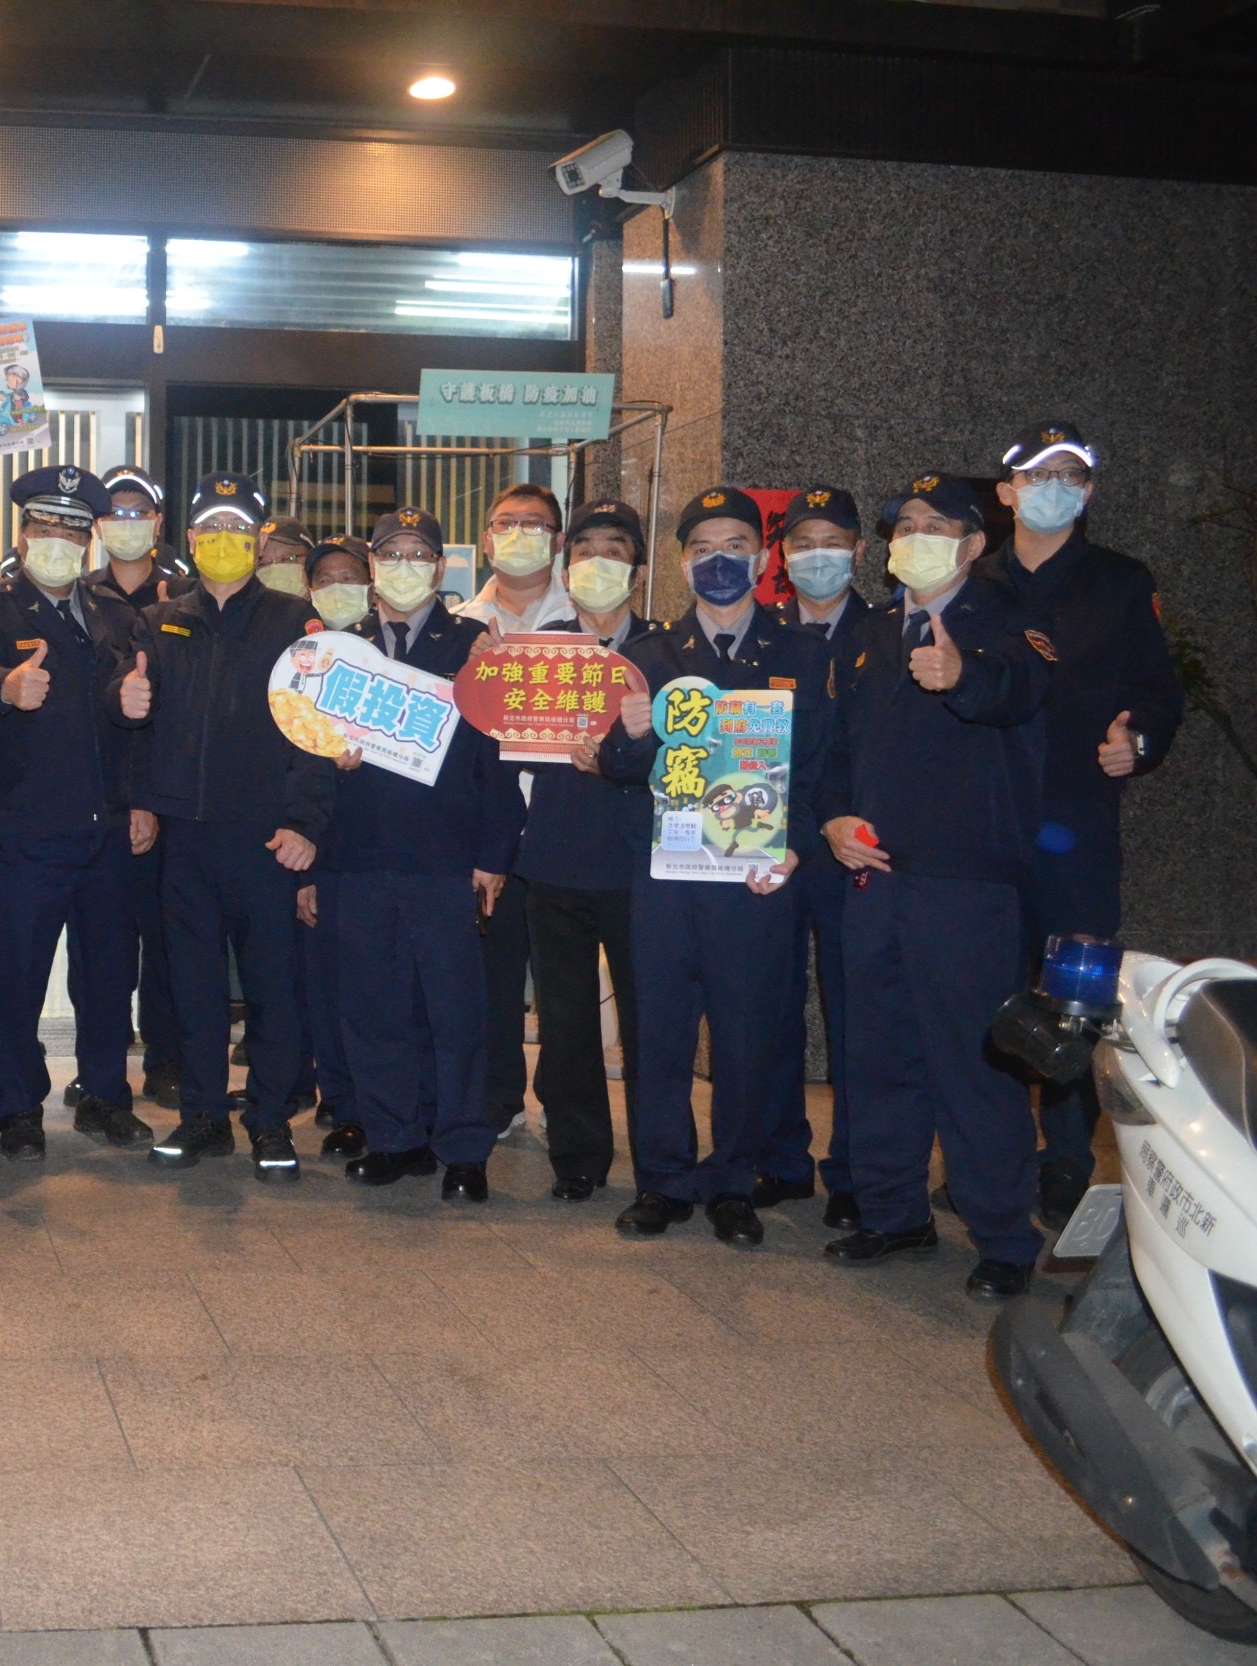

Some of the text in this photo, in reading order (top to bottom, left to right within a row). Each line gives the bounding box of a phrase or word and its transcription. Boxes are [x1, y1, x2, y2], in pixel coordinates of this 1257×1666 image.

[440, 381, 598, 406] 守護板橋 防疫加油
[476, 661, 628, 687] 加強重要節日
[320, 662, 450, 750] 假投資
[503, 687, 607, 714] 安全維護
[715, 700, 785, 715] 防竊有一套
[720, 718, 790, 734] 到府免費教
